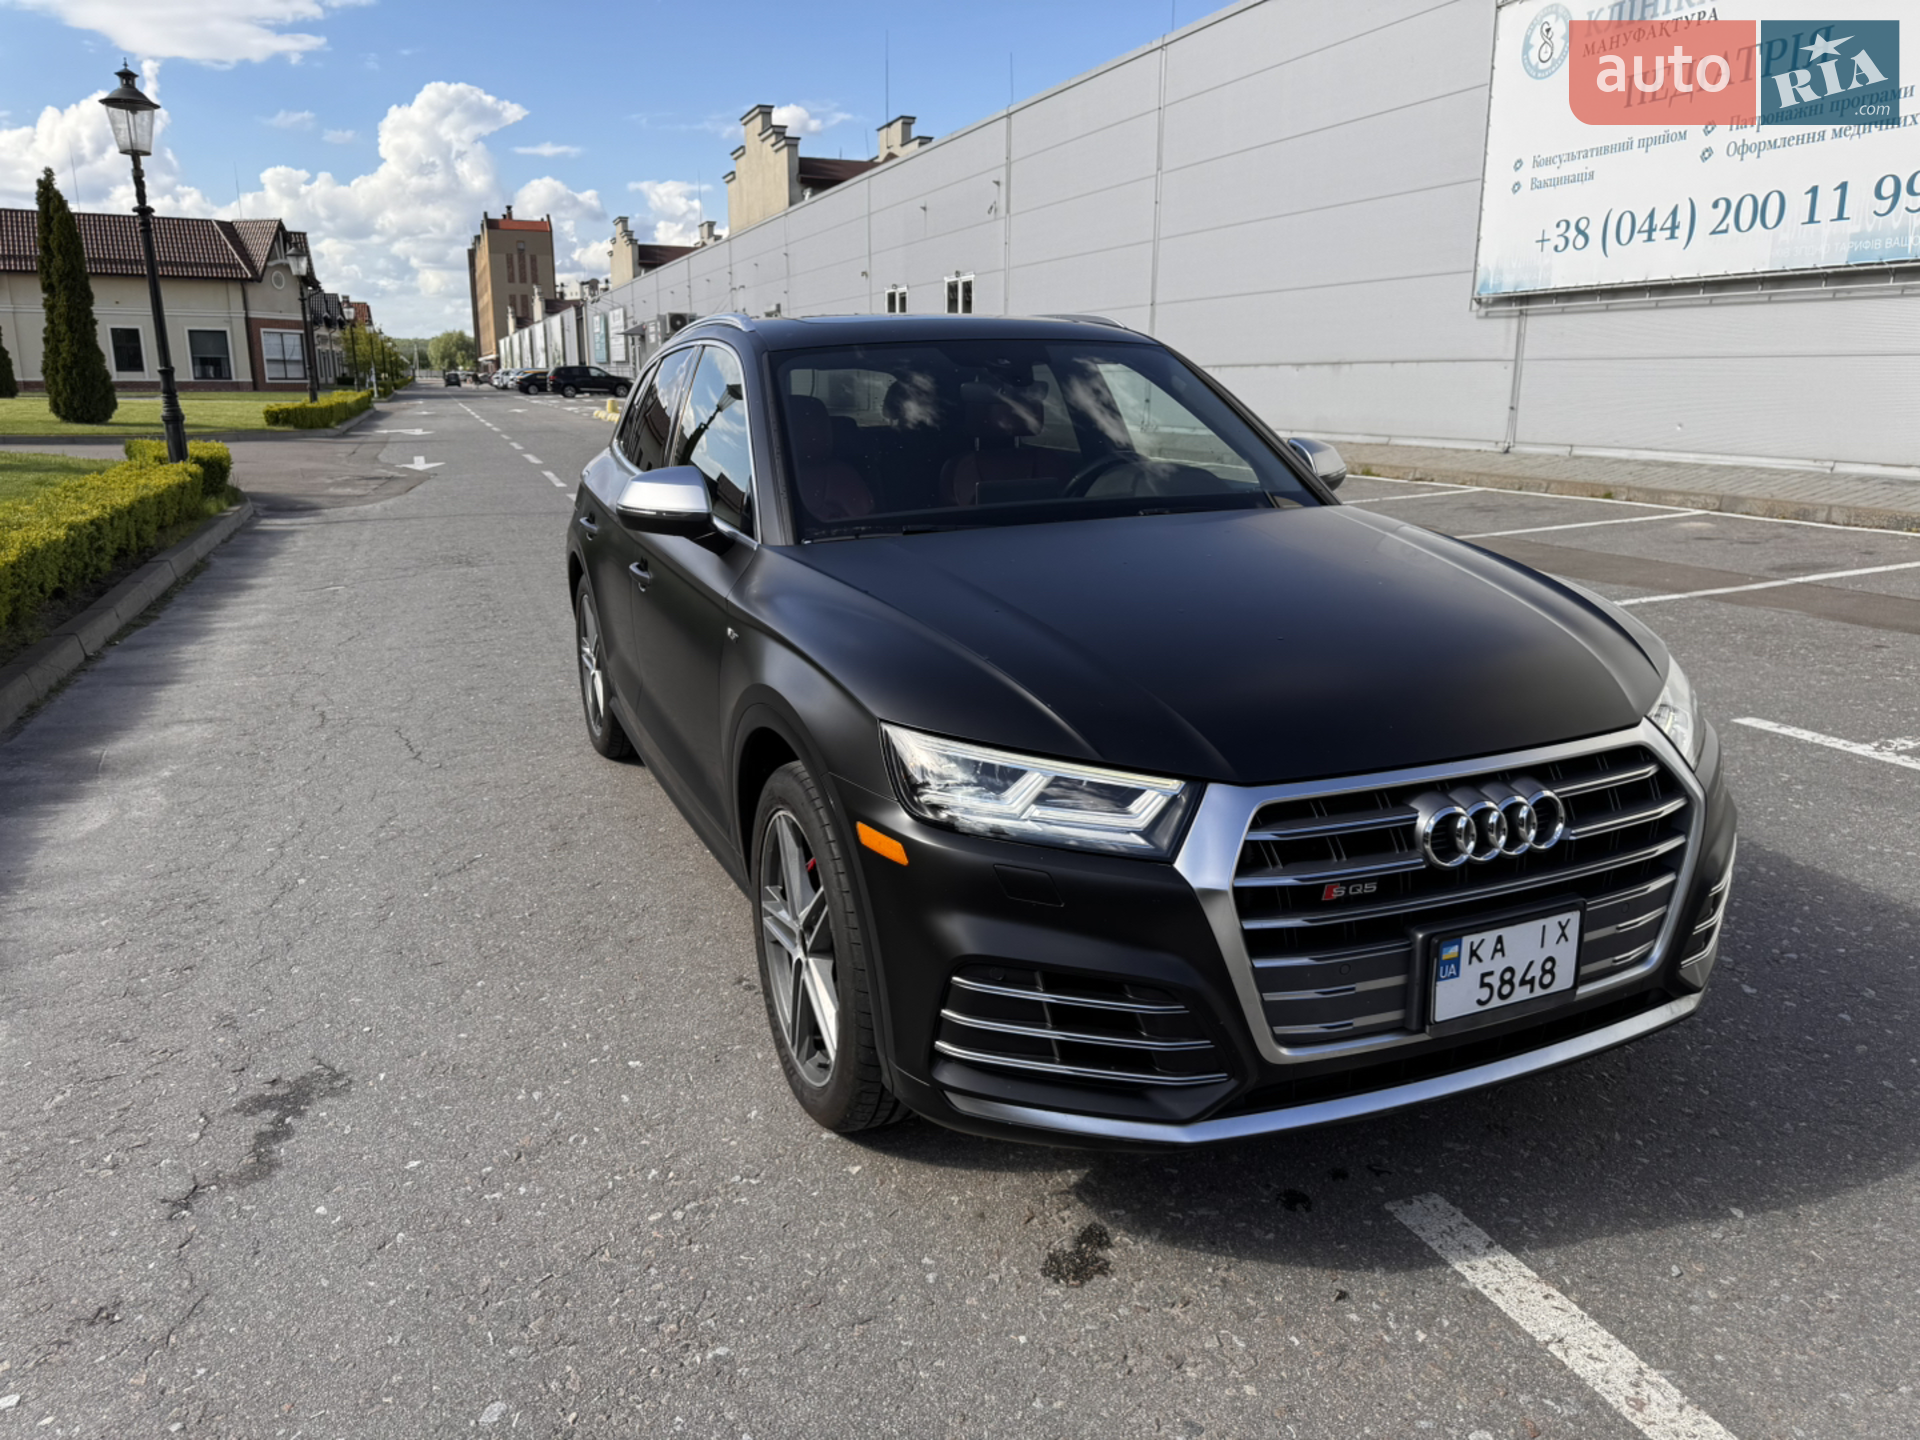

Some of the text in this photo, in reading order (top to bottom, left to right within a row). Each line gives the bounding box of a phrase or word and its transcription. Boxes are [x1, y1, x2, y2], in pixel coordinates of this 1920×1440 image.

[1582, 7, 1719, 58] МАНУФАКТУРА
[1728, 85, 1916, 133] Патронажні програми
[1531, 129, 1688, 170] Консультативний прийом
[1726, 112, 1920, 162] Оформлення медичних
[1530, 166, 1595, 191] Вакцинація
[1535, 216, 1591, 253] +38
[1600, 196, 1697, 258] (044)
[1708, 189, 1787, 236] 200
[1800, 180, 1851, 226] 11
[1468, 918, 1571, 966] KA IX
[1439, 963, 1457, 980] UA
[1475, 955, 1557, 1007] 5848
